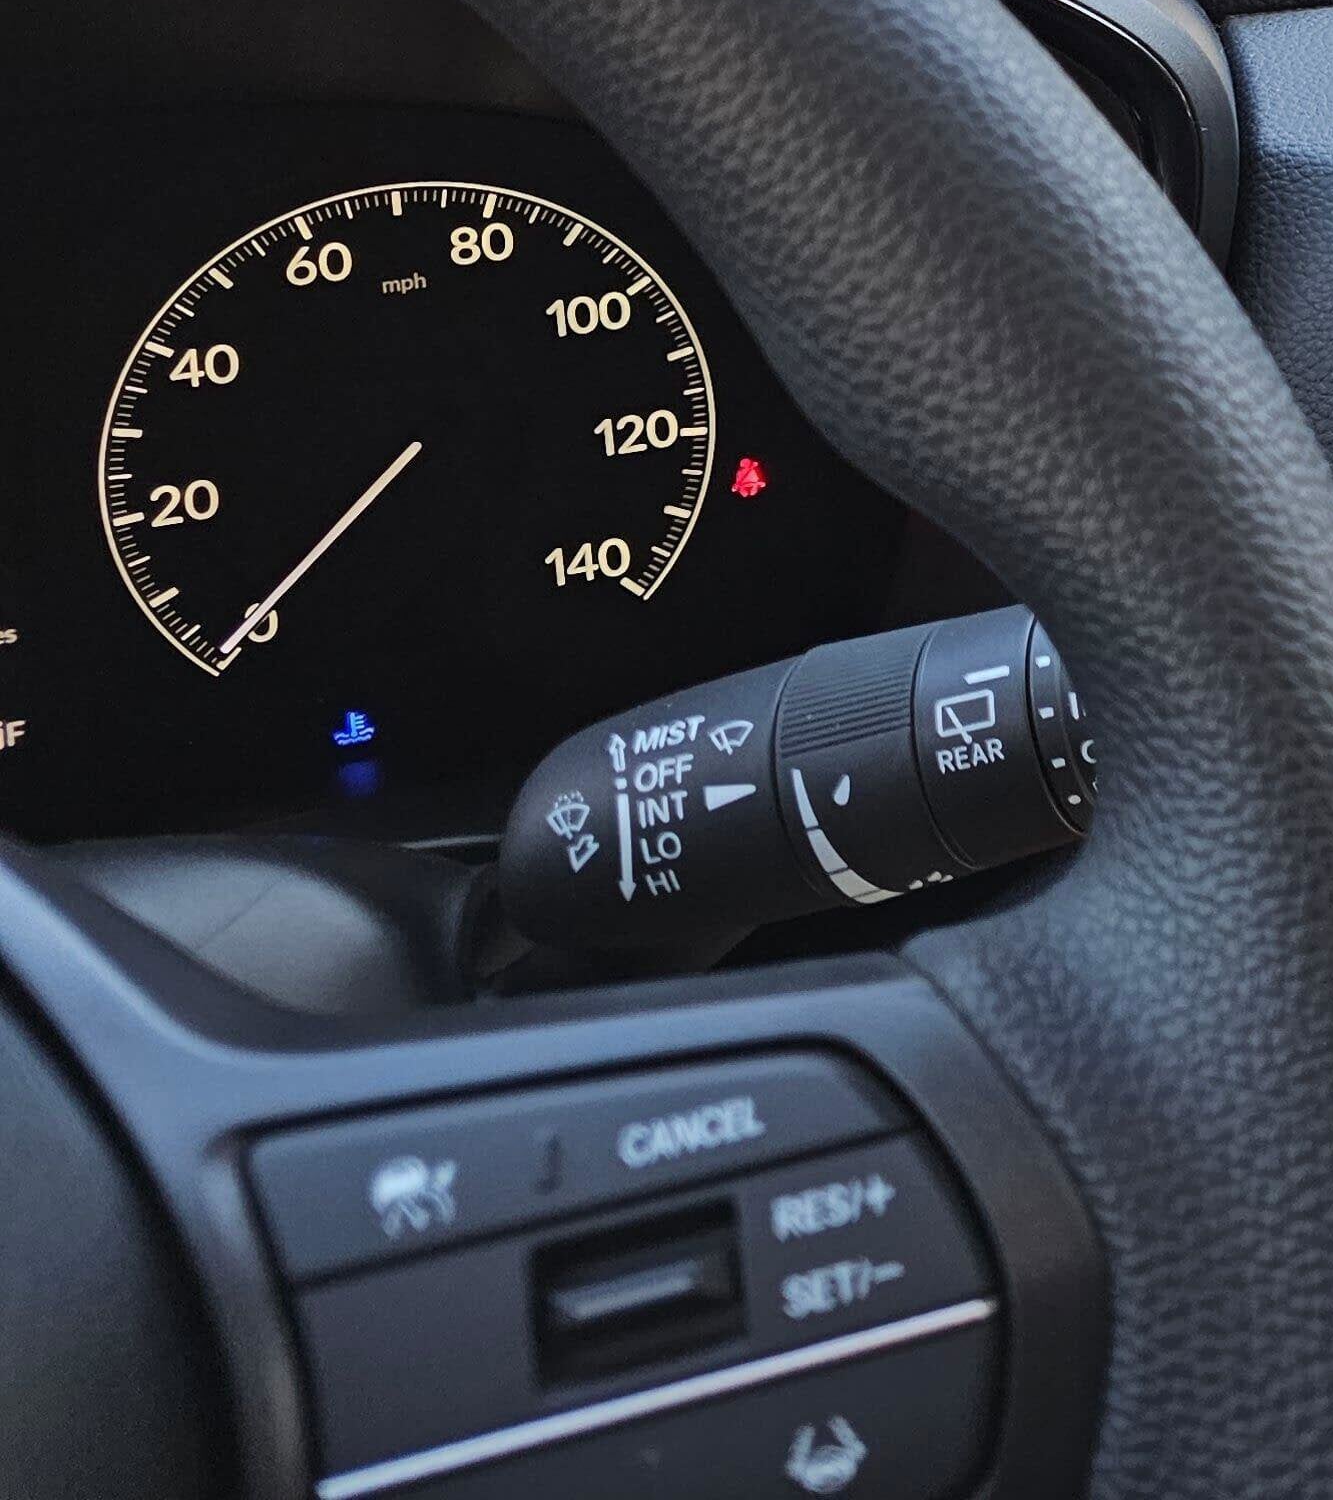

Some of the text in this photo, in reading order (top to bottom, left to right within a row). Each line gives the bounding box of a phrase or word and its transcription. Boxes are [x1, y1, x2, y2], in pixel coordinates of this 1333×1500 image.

[286, 242, 352, 285] 60
[451, 223, 513, 265] 80
[383, 273, 426, 294] mph
[546, 291, 631, 337] 100
[169, 344, 239, 387] 40
[594, 410, 679, 456] 120
[150, 480, 219, 527] 20
[545, 538, 630, 585] 140
[633, 716, 706, 754] MIST
[634, 755, 693, 792] OFF
[935, 739, 1005, 774] REAR
[637, 791, 687, 828] INT
[640, 832, 681, 863] LO
[646, 870, 680, 895] HI
[618, 1097, 764, 1167] CANCEL
